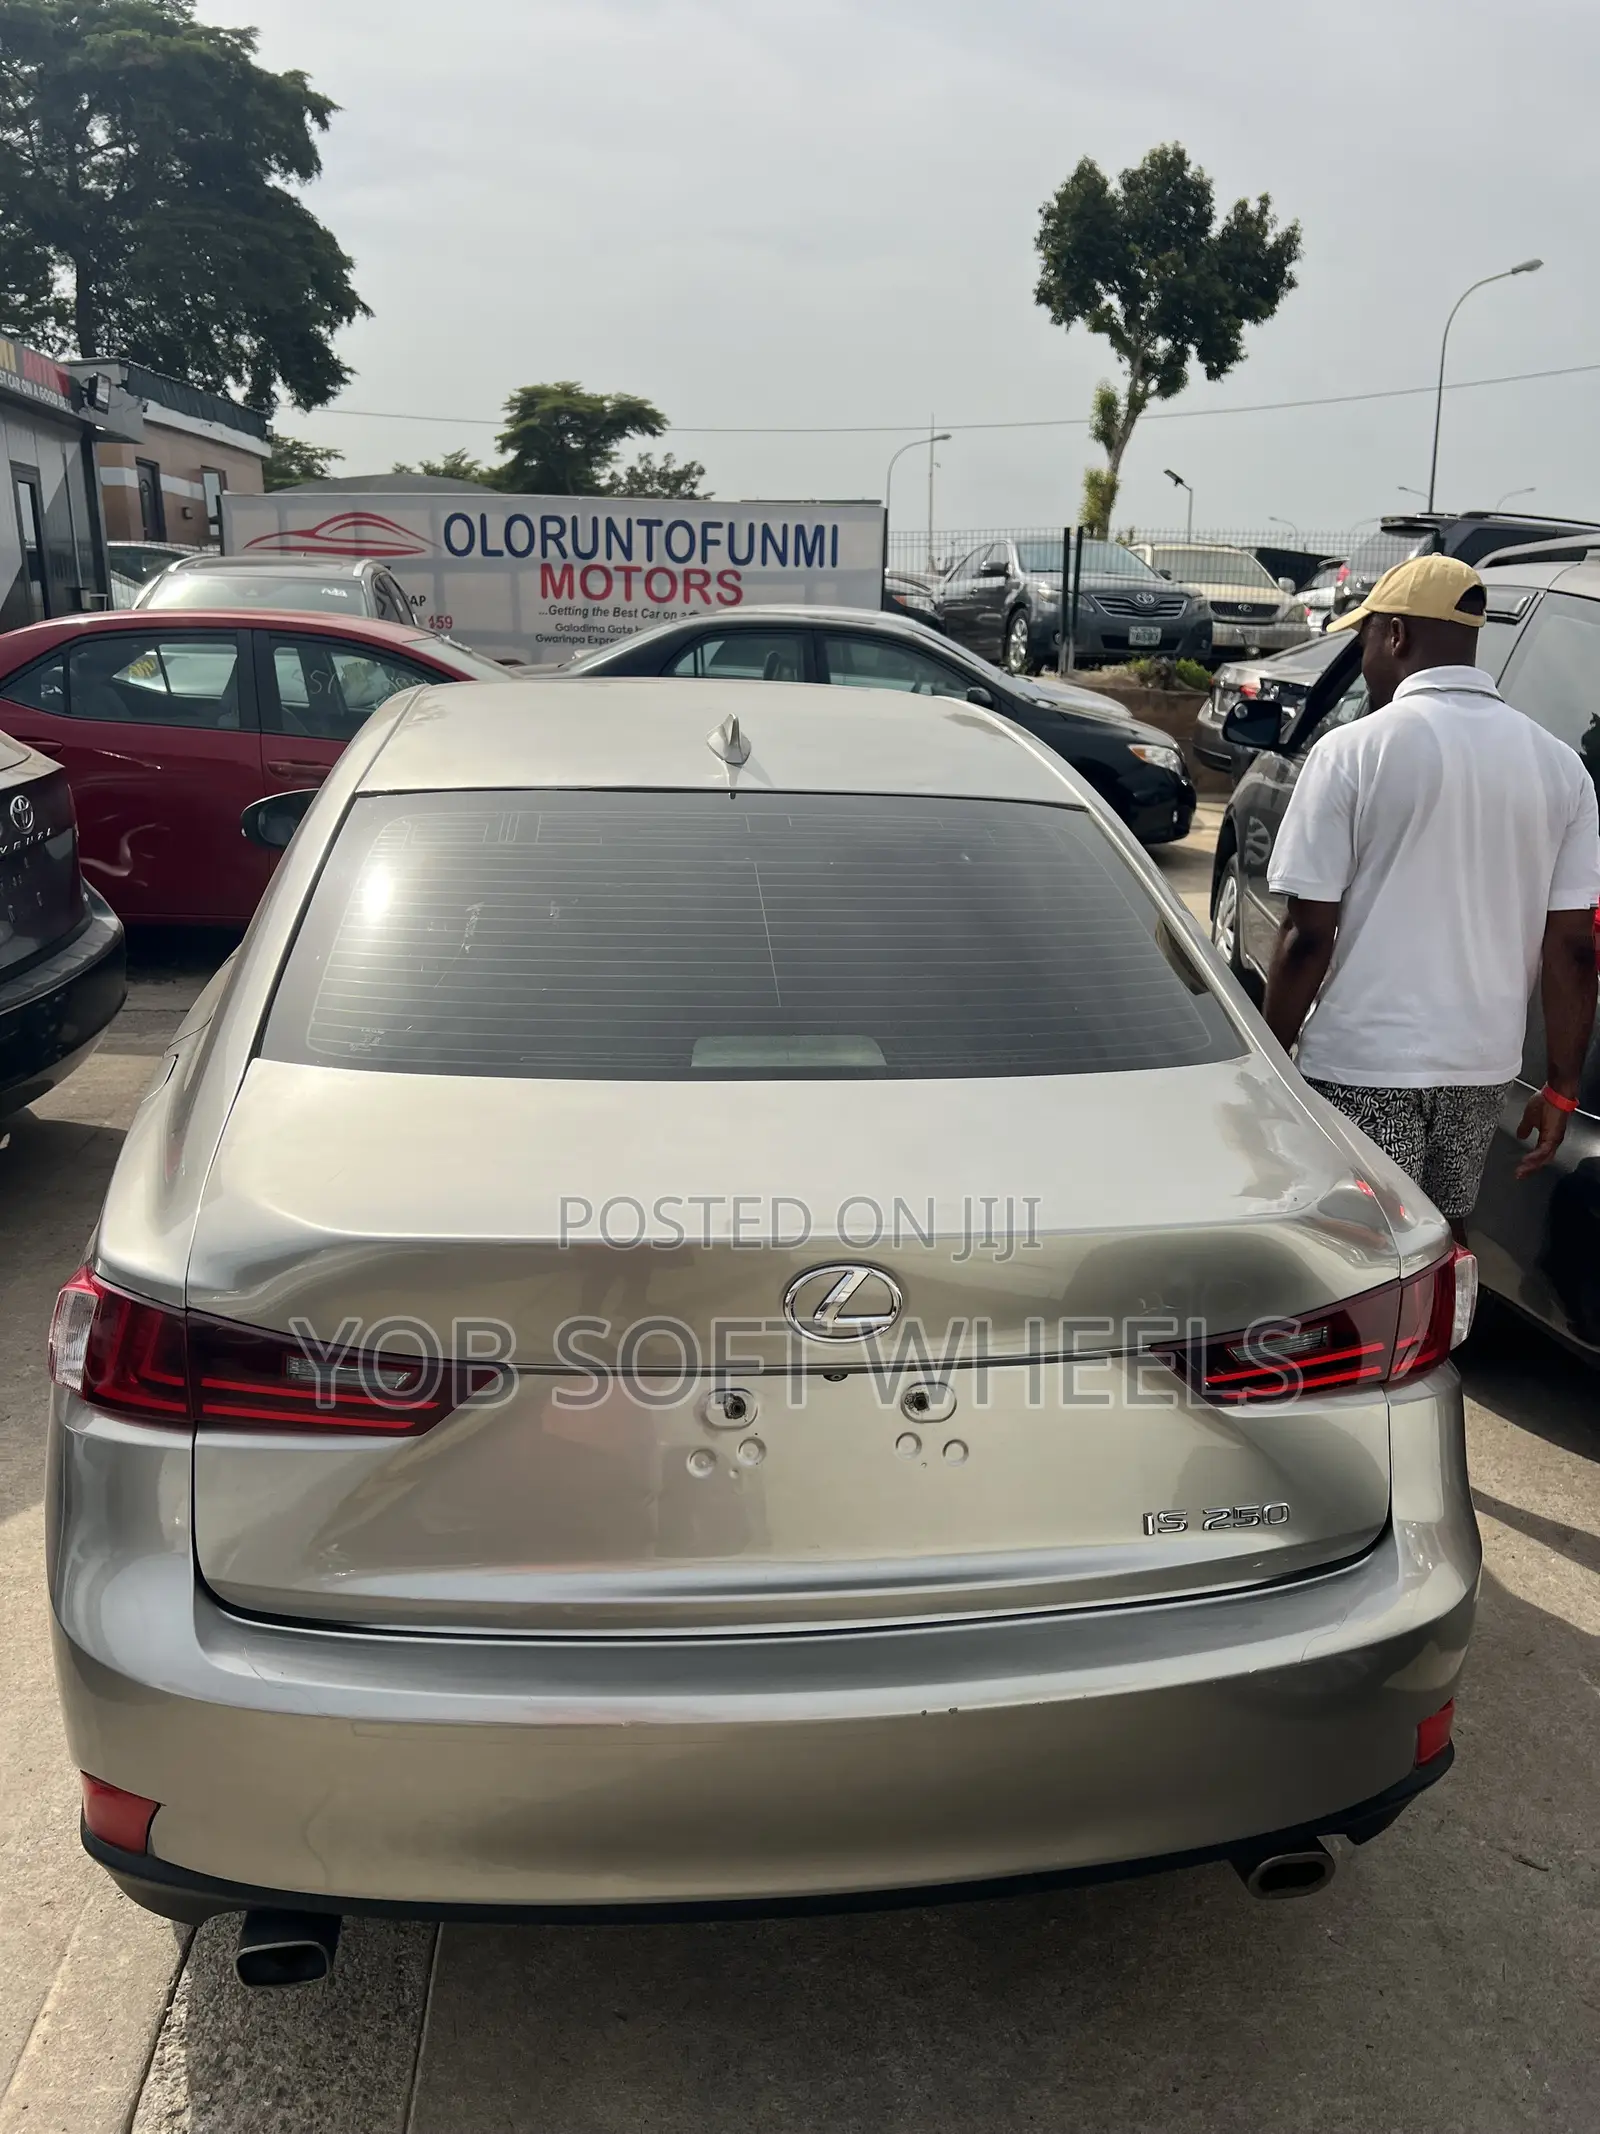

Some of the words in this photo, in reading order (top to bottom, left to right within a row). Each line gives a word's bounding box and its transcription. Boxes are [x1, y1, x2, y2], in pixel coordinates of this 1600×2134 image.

[443, 512, 839, 569] OLORUNTOFUNMI
[540, 563, 744, 606] MOTORS
[591, 606, 610, 617] the
[612, 606, 638, 619] Best
[641, 607, 661, 619] Car
[663, 611, 677, 620] on
[1142, 1509, 1188, 1536] IS
[1202, 1501, 1290, 1531] 250
